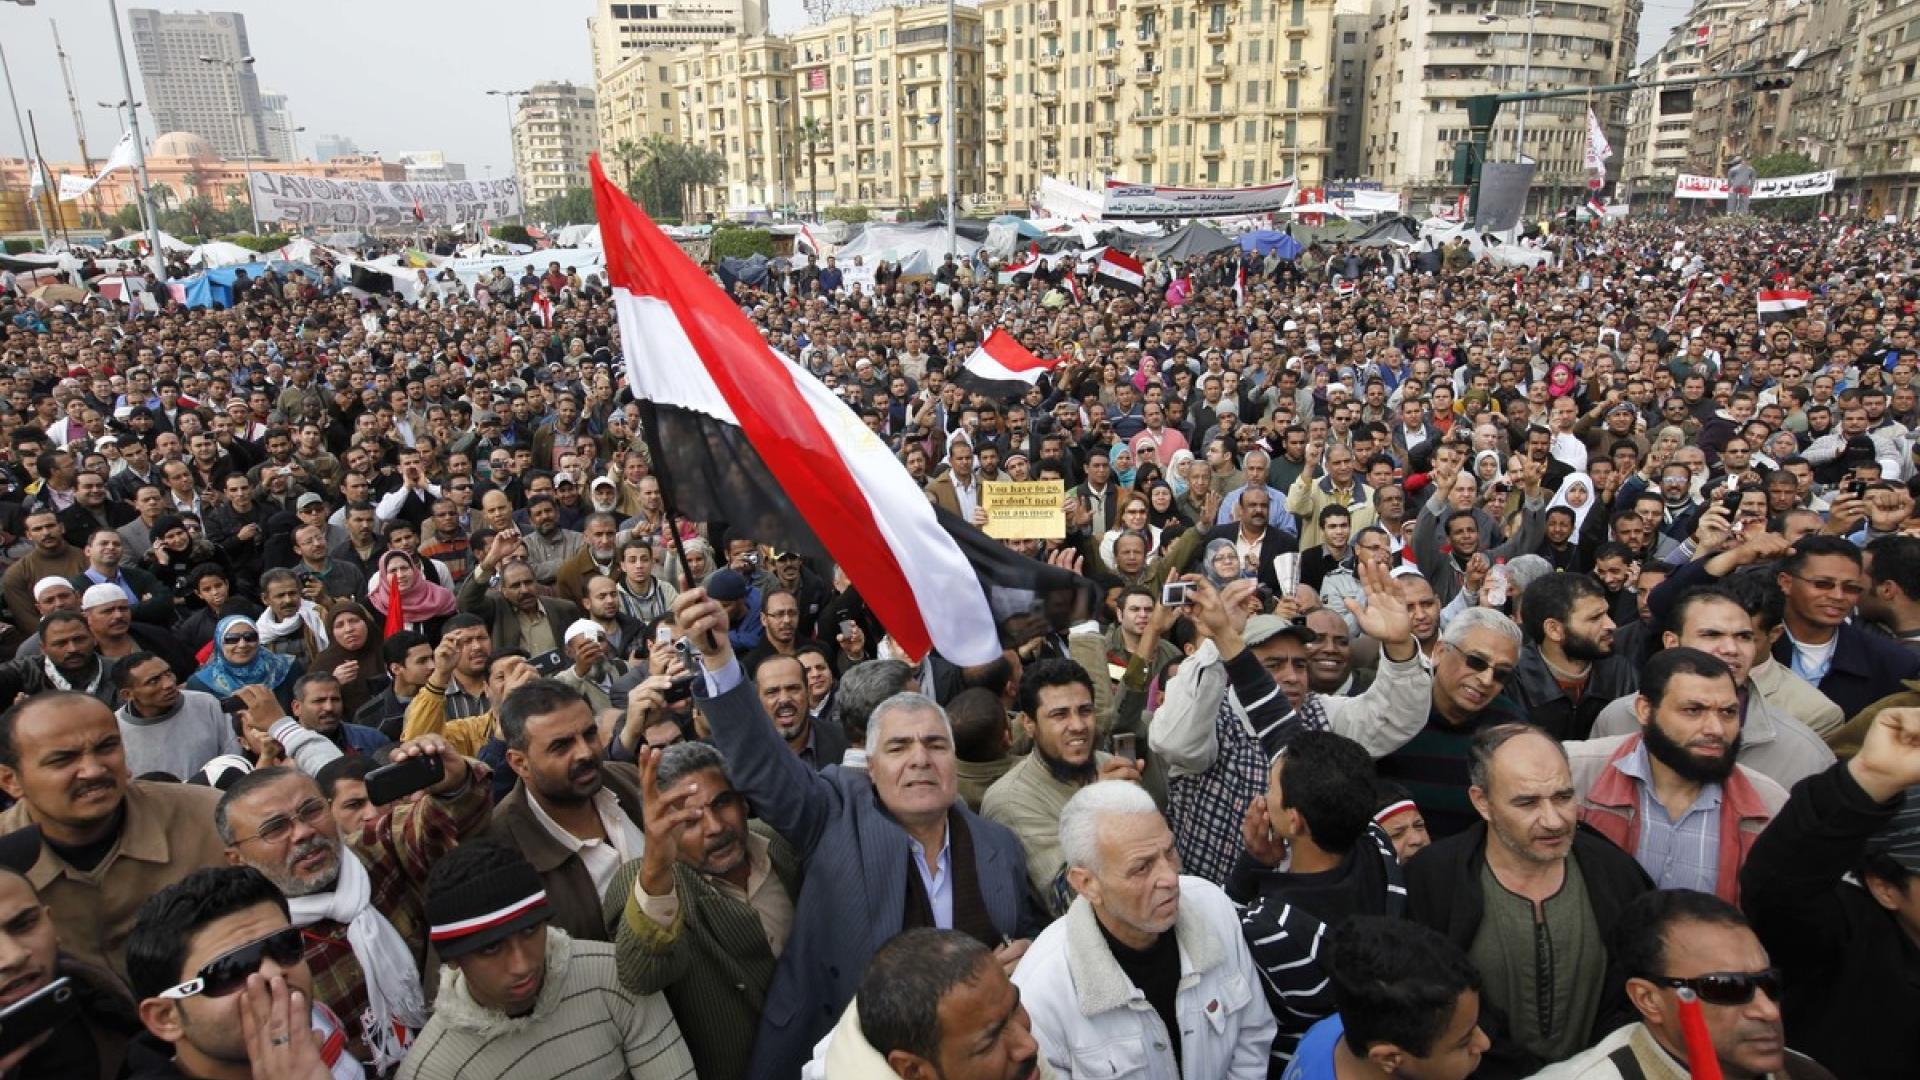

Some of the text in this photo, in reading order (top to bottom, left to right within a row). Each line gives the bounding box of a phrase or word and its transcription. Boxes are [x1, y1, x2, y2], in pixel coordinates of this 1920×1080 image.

[988, 485, 1008, 494] You
[1010, 485, 1033, 494] have
[1034, 486, 1046, 494] to
[1005, 496, 1033, 504] don't
[1034, 496, 1057, 504] need
[1012, 510, 1056, 518] anymore
